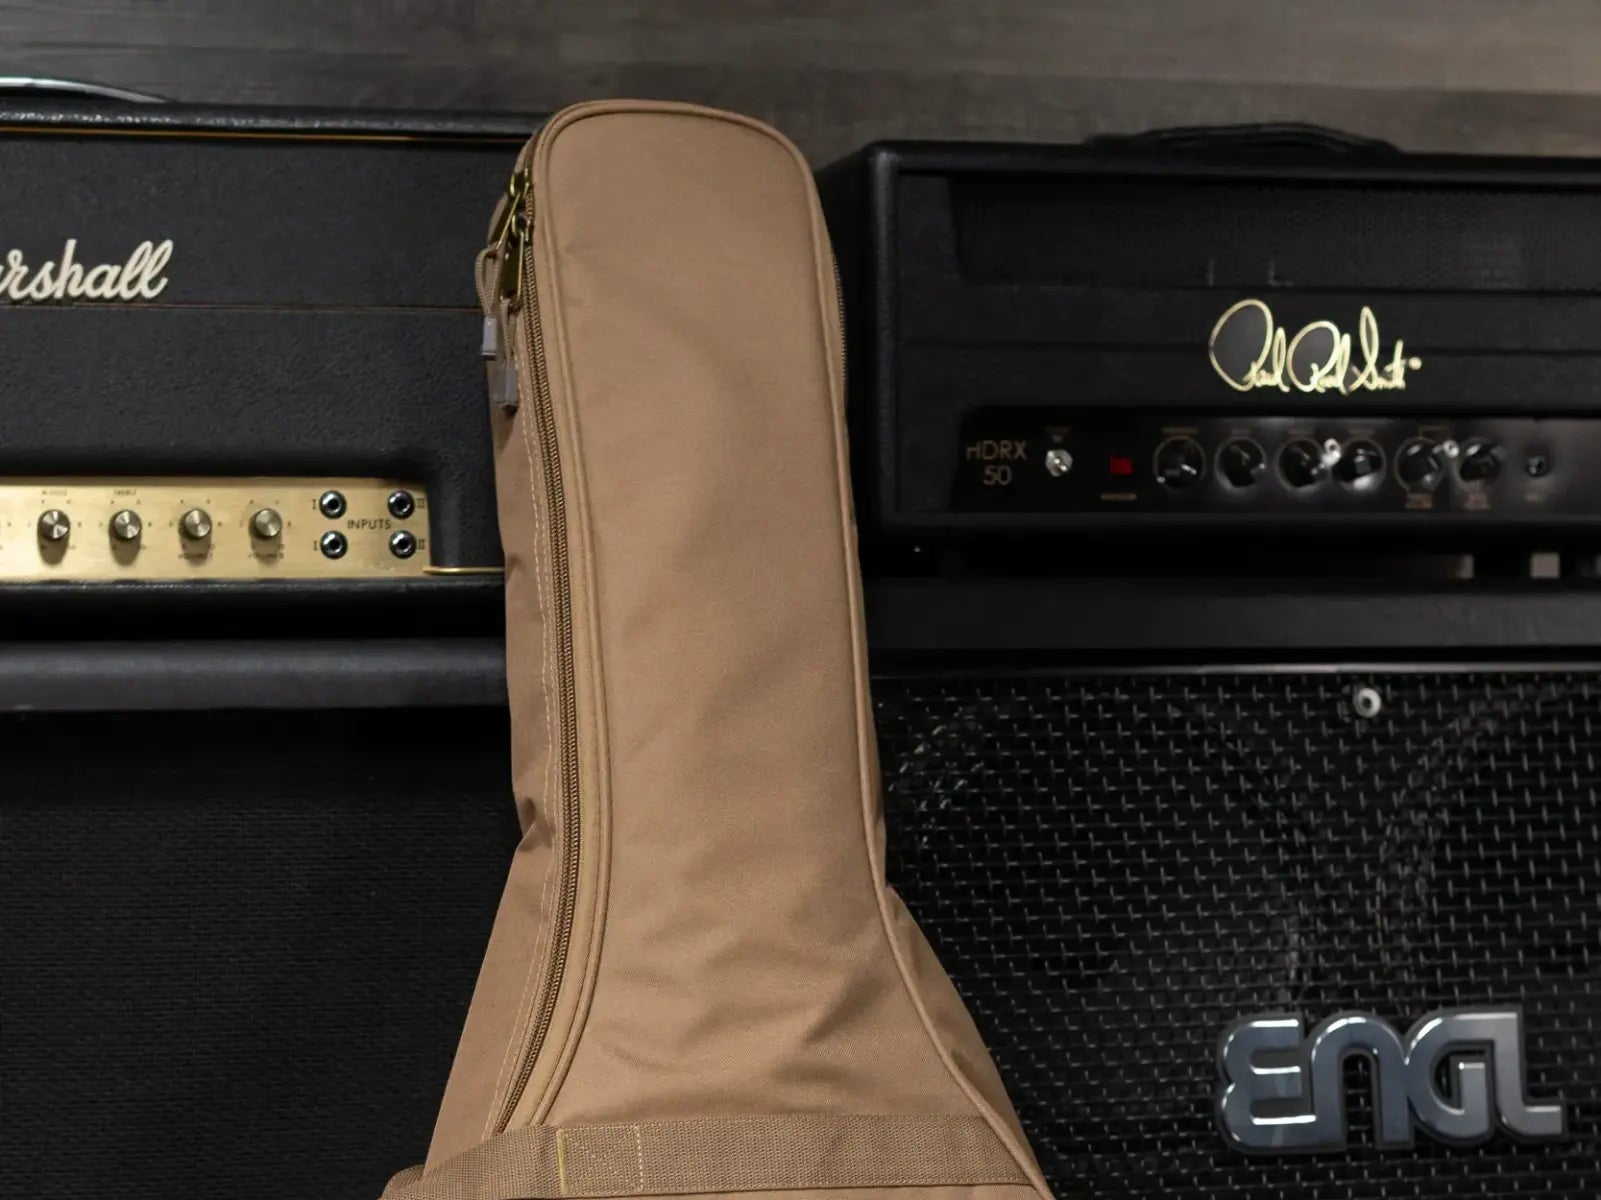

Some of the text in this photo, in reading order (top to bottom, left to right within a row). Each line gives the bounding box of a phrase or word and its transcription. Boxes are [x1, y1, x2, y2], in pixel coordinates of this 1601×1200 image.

[966, 440, 1027, 460] HDRX
[983, 465, 1012, 486] 50
[347, 518, 392, 530] INPUTS
[1218, 1009, 1566, 1154] ENGL
